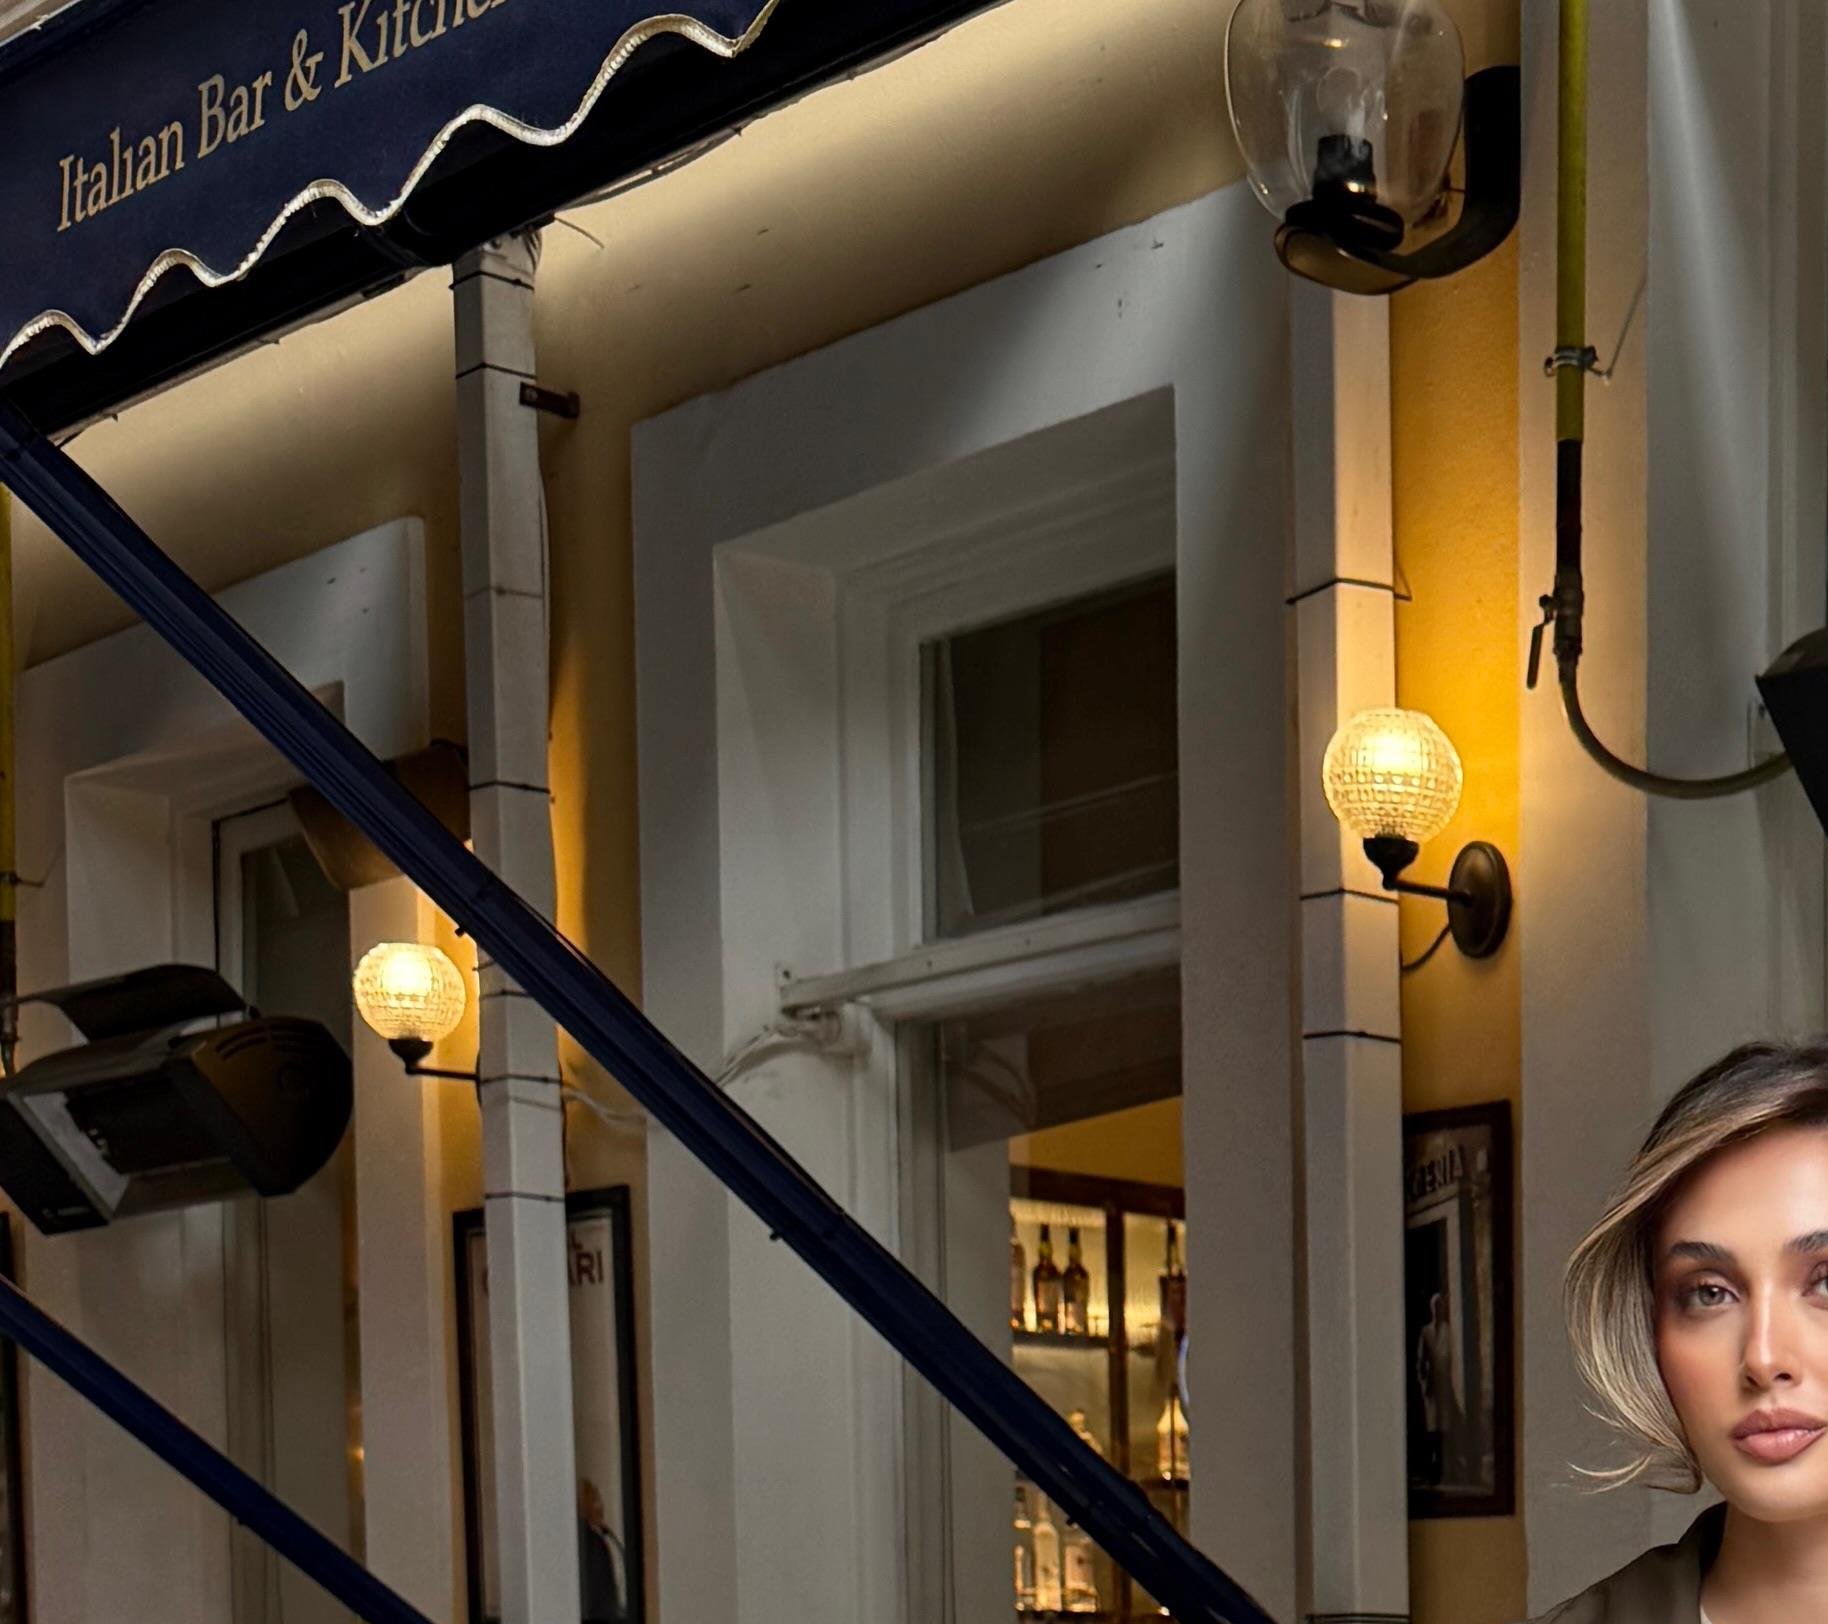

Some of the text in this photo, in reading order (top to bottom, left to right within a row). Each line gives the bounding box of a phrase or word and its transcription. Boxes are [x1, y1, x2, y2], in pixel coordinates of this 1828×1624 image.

[57, 120, 185, 231] Italian
[198, 70, 272, 158] Bar
[284, 29, 325, 110] &
